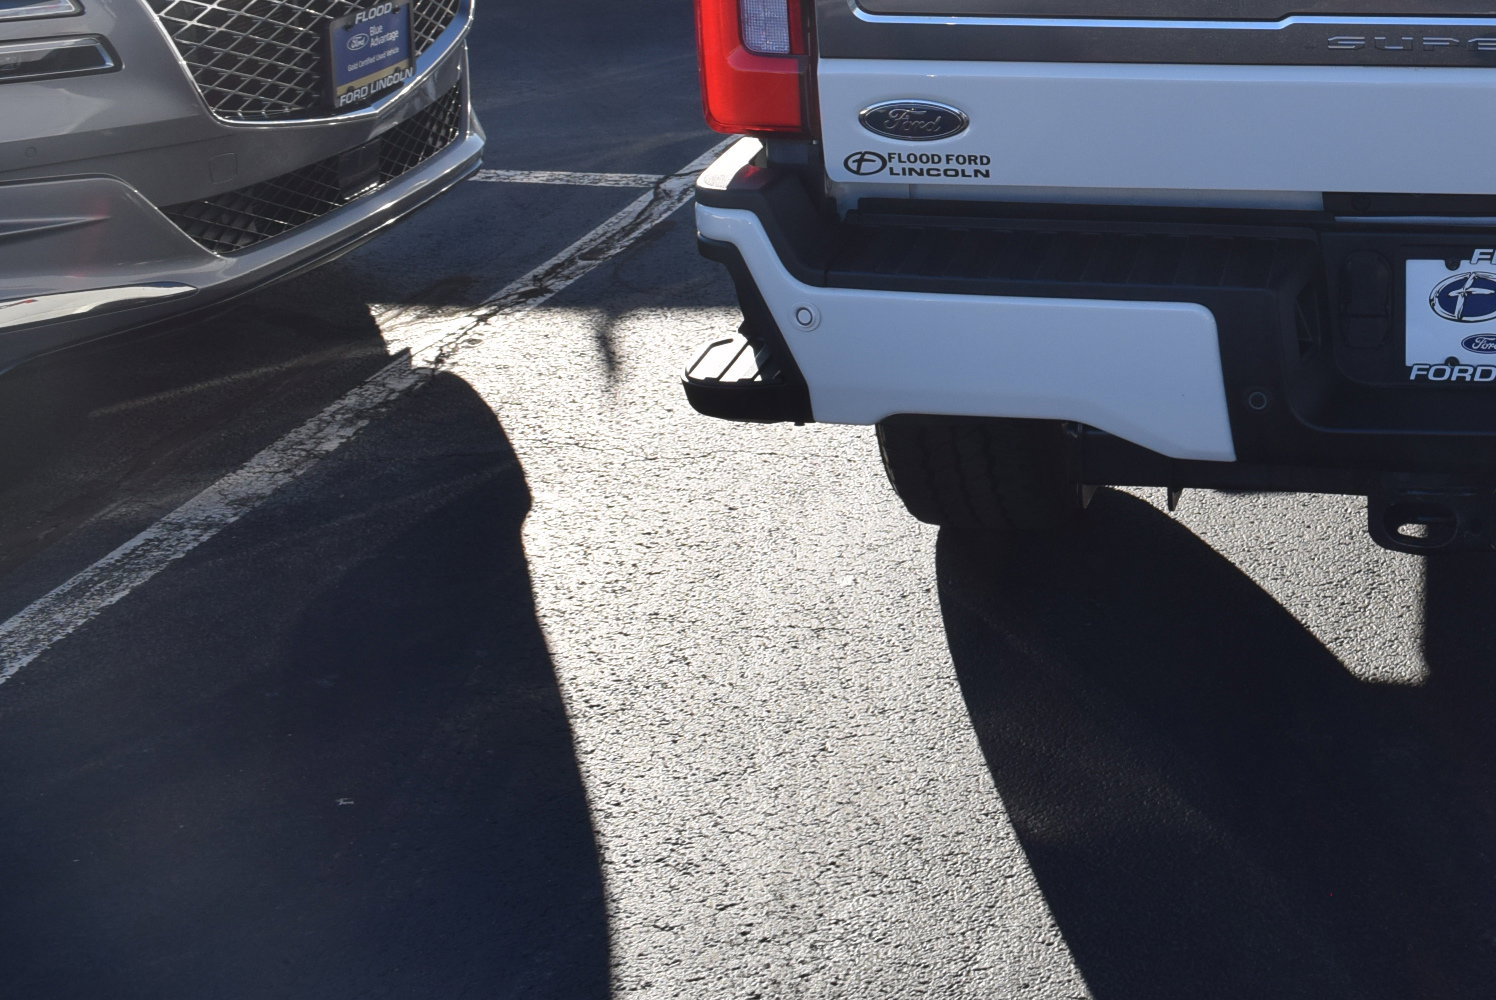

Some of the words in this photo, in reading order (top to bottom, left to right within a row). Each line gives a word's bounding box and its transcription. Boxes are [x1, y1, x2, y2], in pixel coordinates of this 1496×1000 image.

[355, 2, 392, 24] FLOOD
[370, 25, 383, 37] Blue
[370, 30, 399, 47] Advantage
[350, 35, 366, 49] Ford
[340, 87, 368, 106] FORD
[371, 67, 413, 93] LINCOLN
[884, 108, 942, 132] Ford
[887, 152, 942, 164] FLOOD
[945, 154, 991, 166] FORD
[889, 167, 991, 178] LINCOLN
